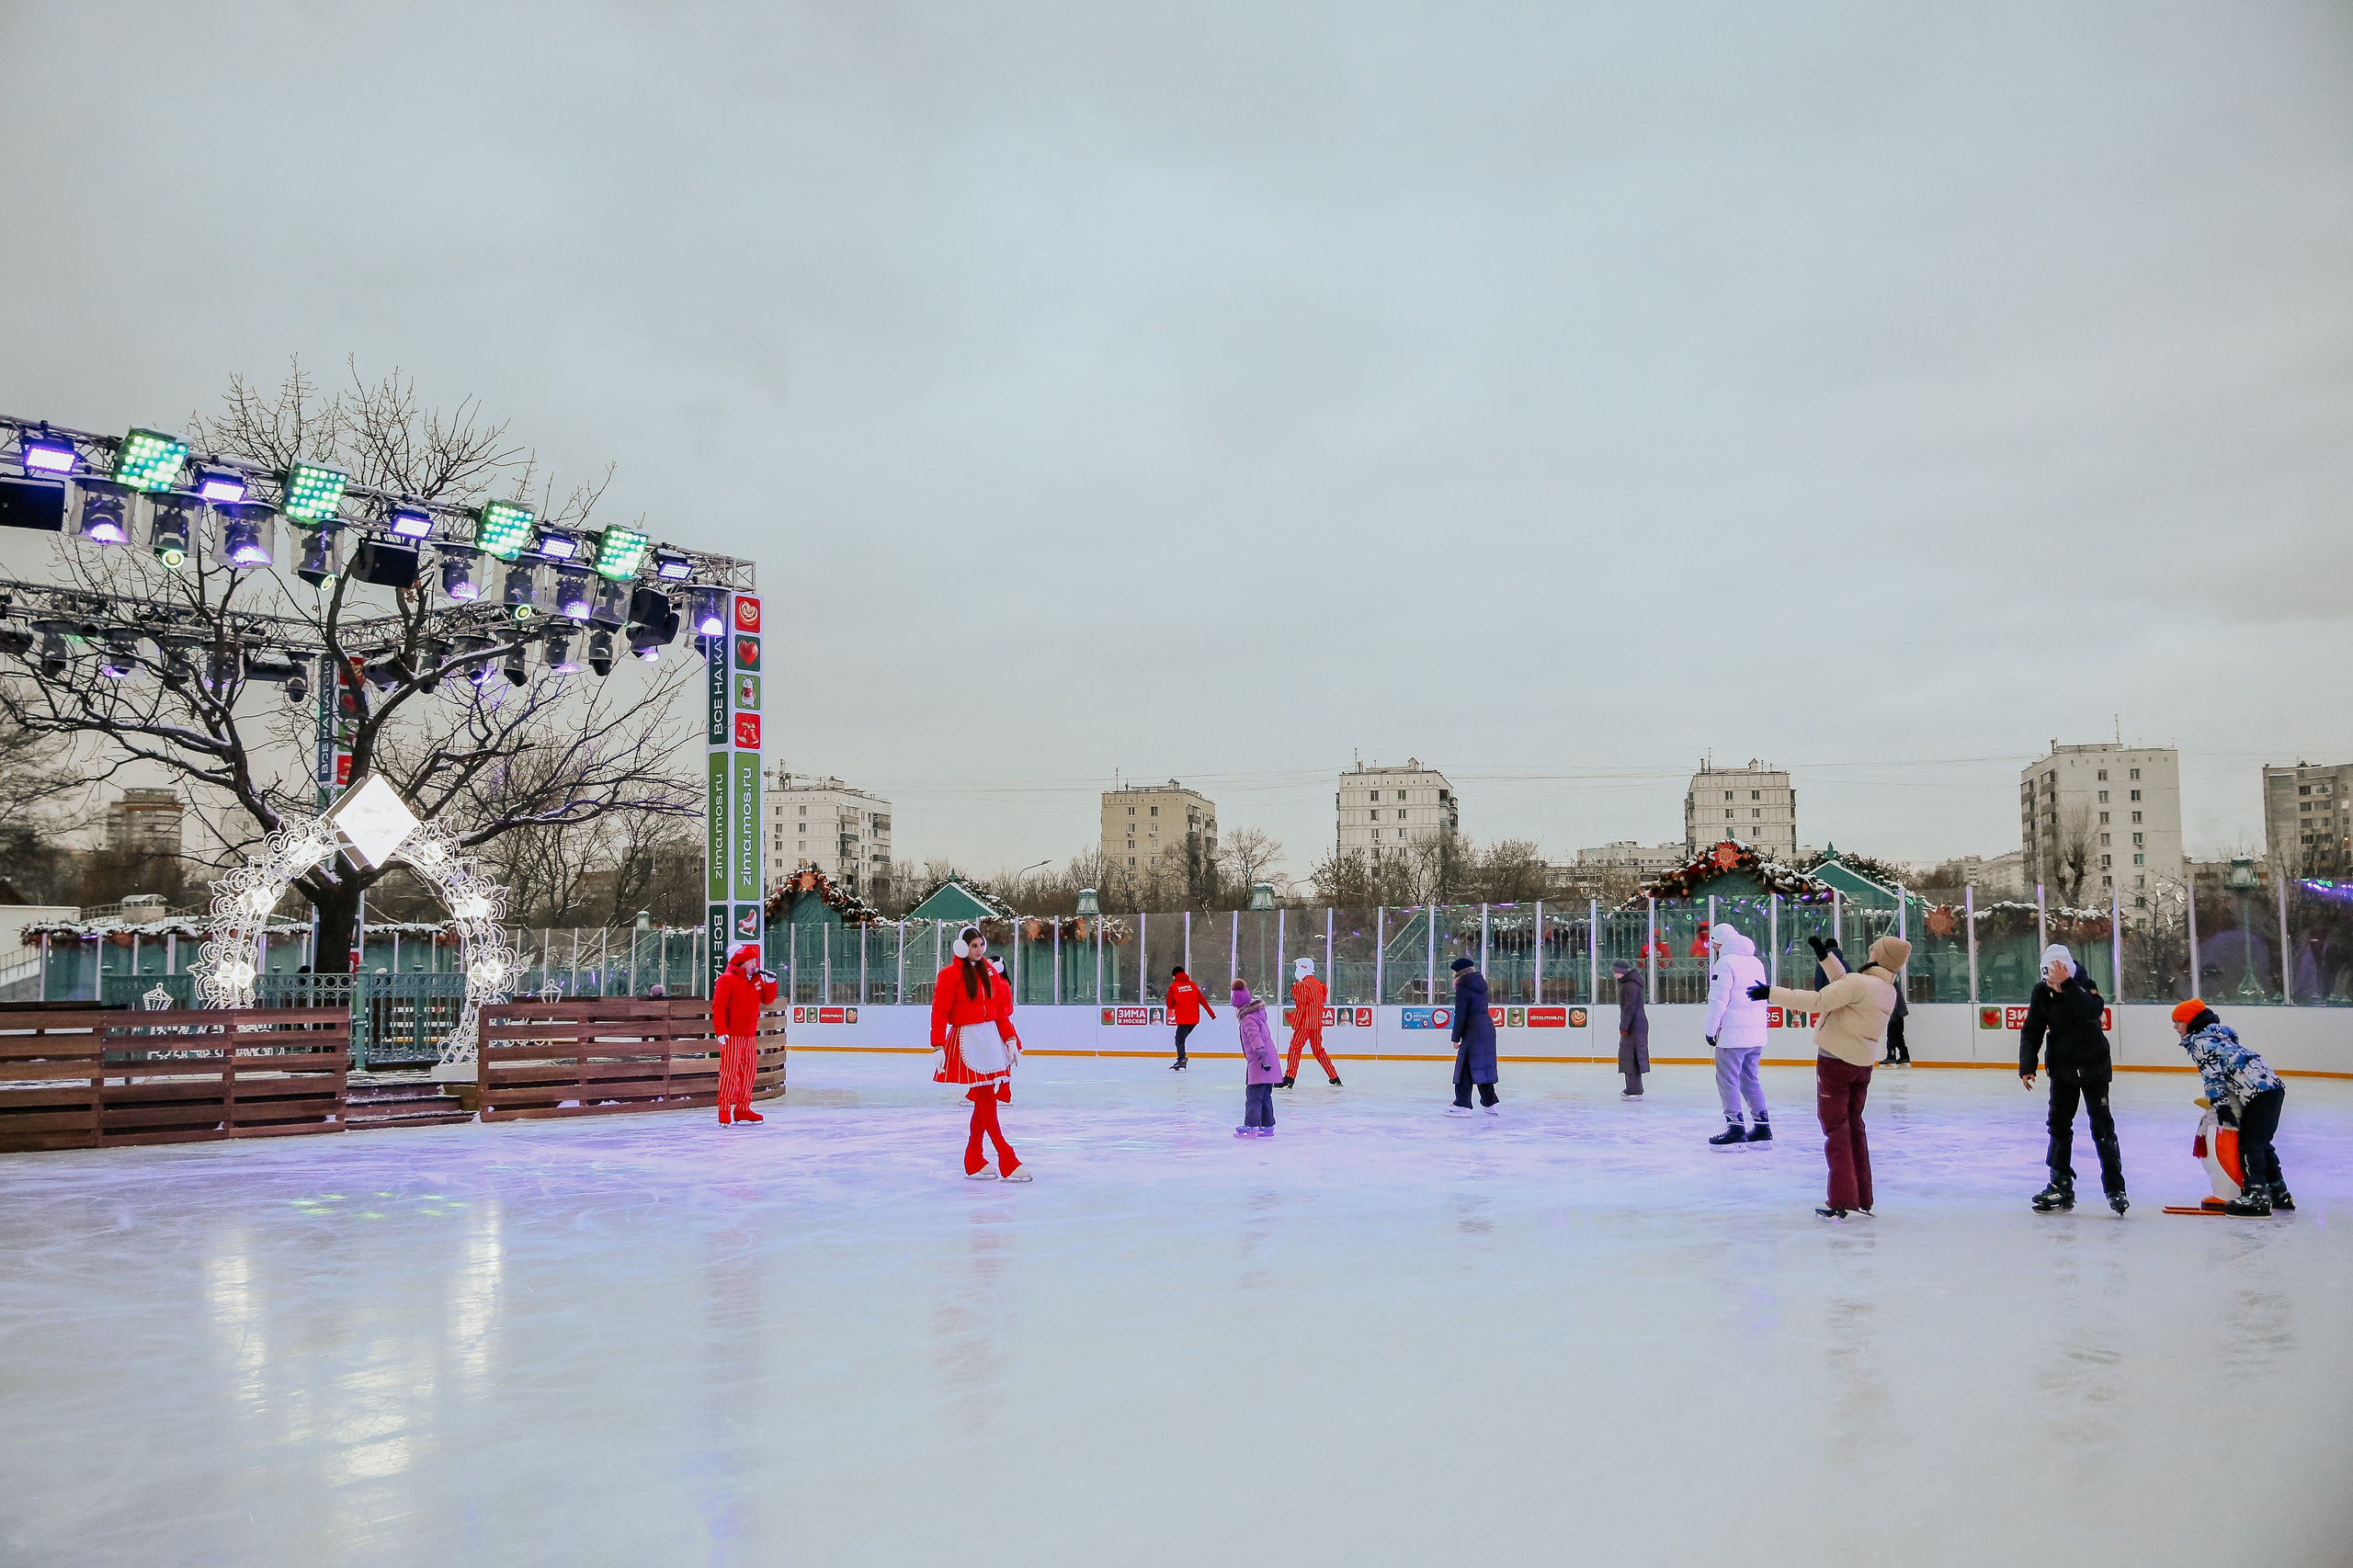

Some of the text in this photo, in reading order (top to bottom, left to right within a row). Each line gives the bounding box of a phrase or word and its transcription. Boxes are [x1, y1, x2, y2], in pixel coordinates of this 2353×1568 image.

[714, 636, 723, 734] ВСЕ НА КАТ
[714, 773, 723, 880] zima.mos.ru
[741, 767, 752, 886] zima.mos.ru
[714, 915, 723, 951] ВСЕ
[1118, 1009, 1146, 1018] ЗИМА
[1767, 1012, 1779, 1022] 25
[2007, 1009, 2029, 1020] ЗИ
